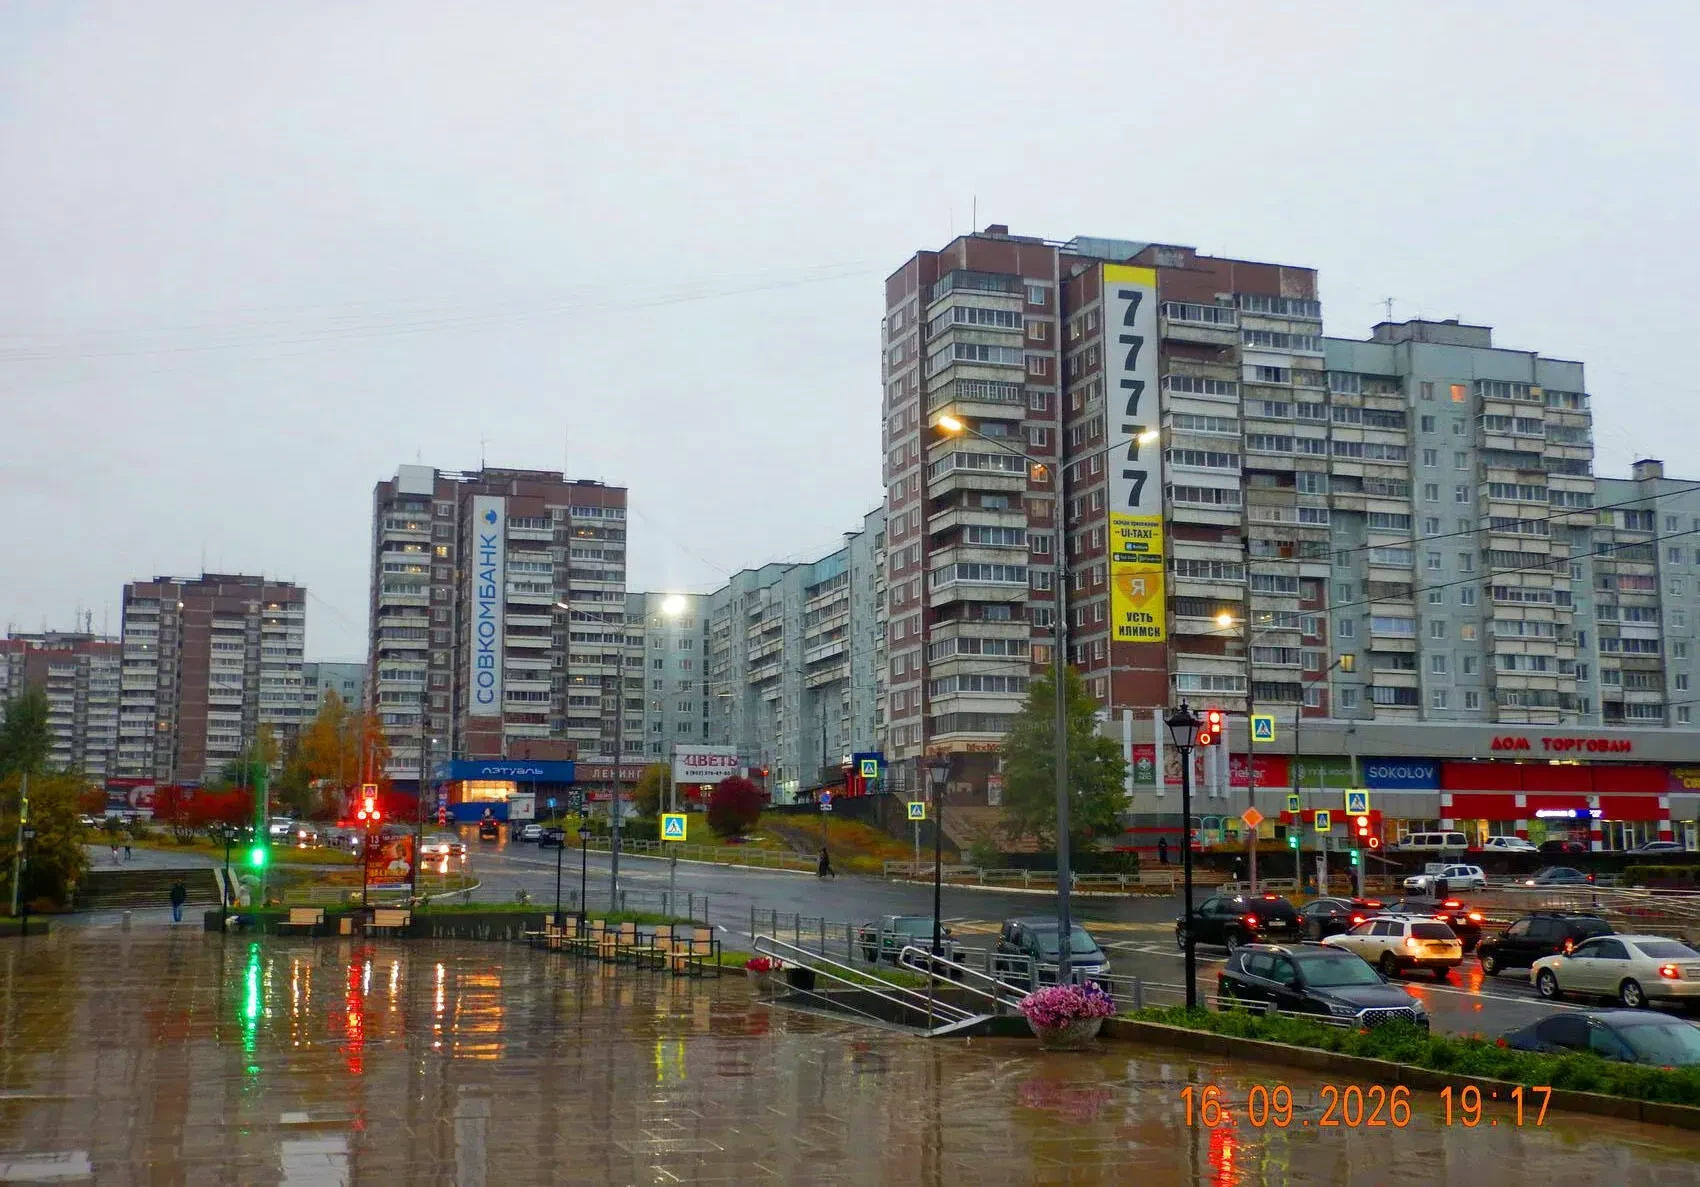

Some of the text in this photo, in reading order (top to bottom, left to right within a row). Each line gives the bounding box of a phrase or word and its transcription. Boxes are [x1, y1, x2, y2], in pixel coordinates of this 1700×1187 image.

[476, 534, 497, 704] СОВКОМБАНК
[1490, 736, 1531, 751] ДОМ
[1368, 766, 1434, 779] SOKOLOV
